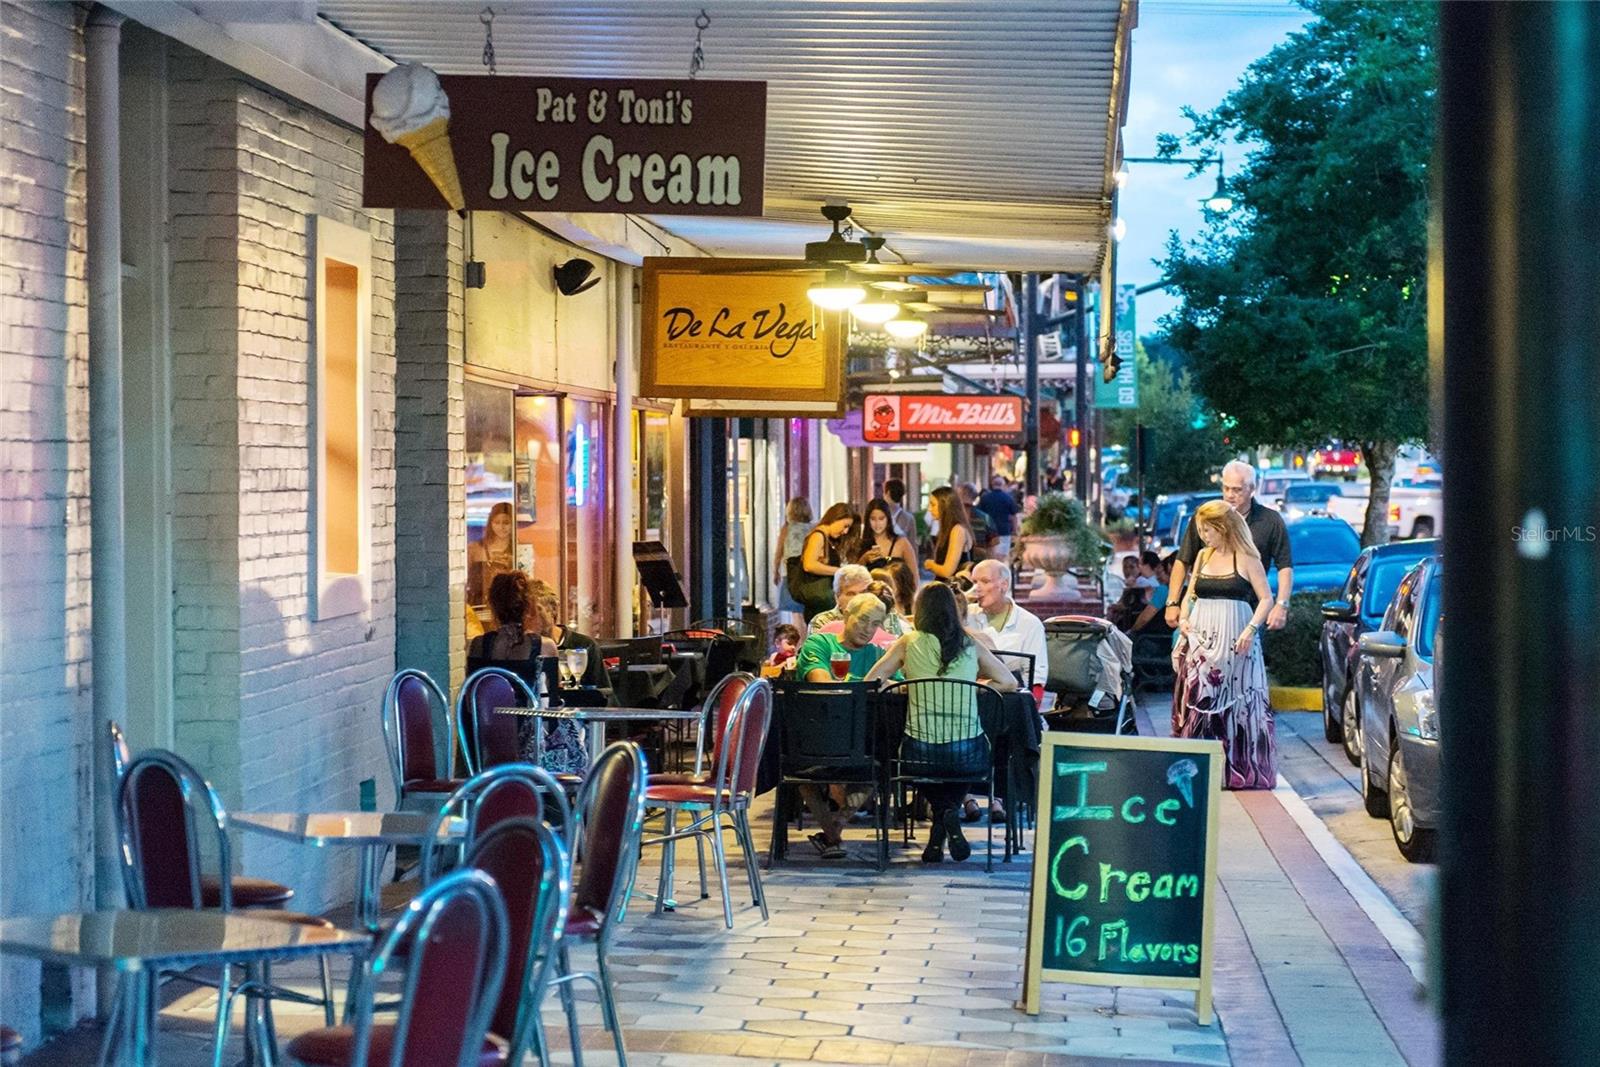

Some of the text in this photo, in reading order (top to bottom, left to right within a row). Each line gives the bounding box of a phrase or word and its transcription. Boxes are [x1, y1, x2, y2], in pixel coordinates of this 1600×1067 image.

[536, 88, 693, 125] Pat & Toni's
[489, 132, 742, 206] Ice Cream
[663, 303, 820, 359] De La Vega
[1053, 761, 1182, 827] Ice
[1051, 836, 1199, 903] Cream
[1055, 915, 1200, 964] 16 Flavors
